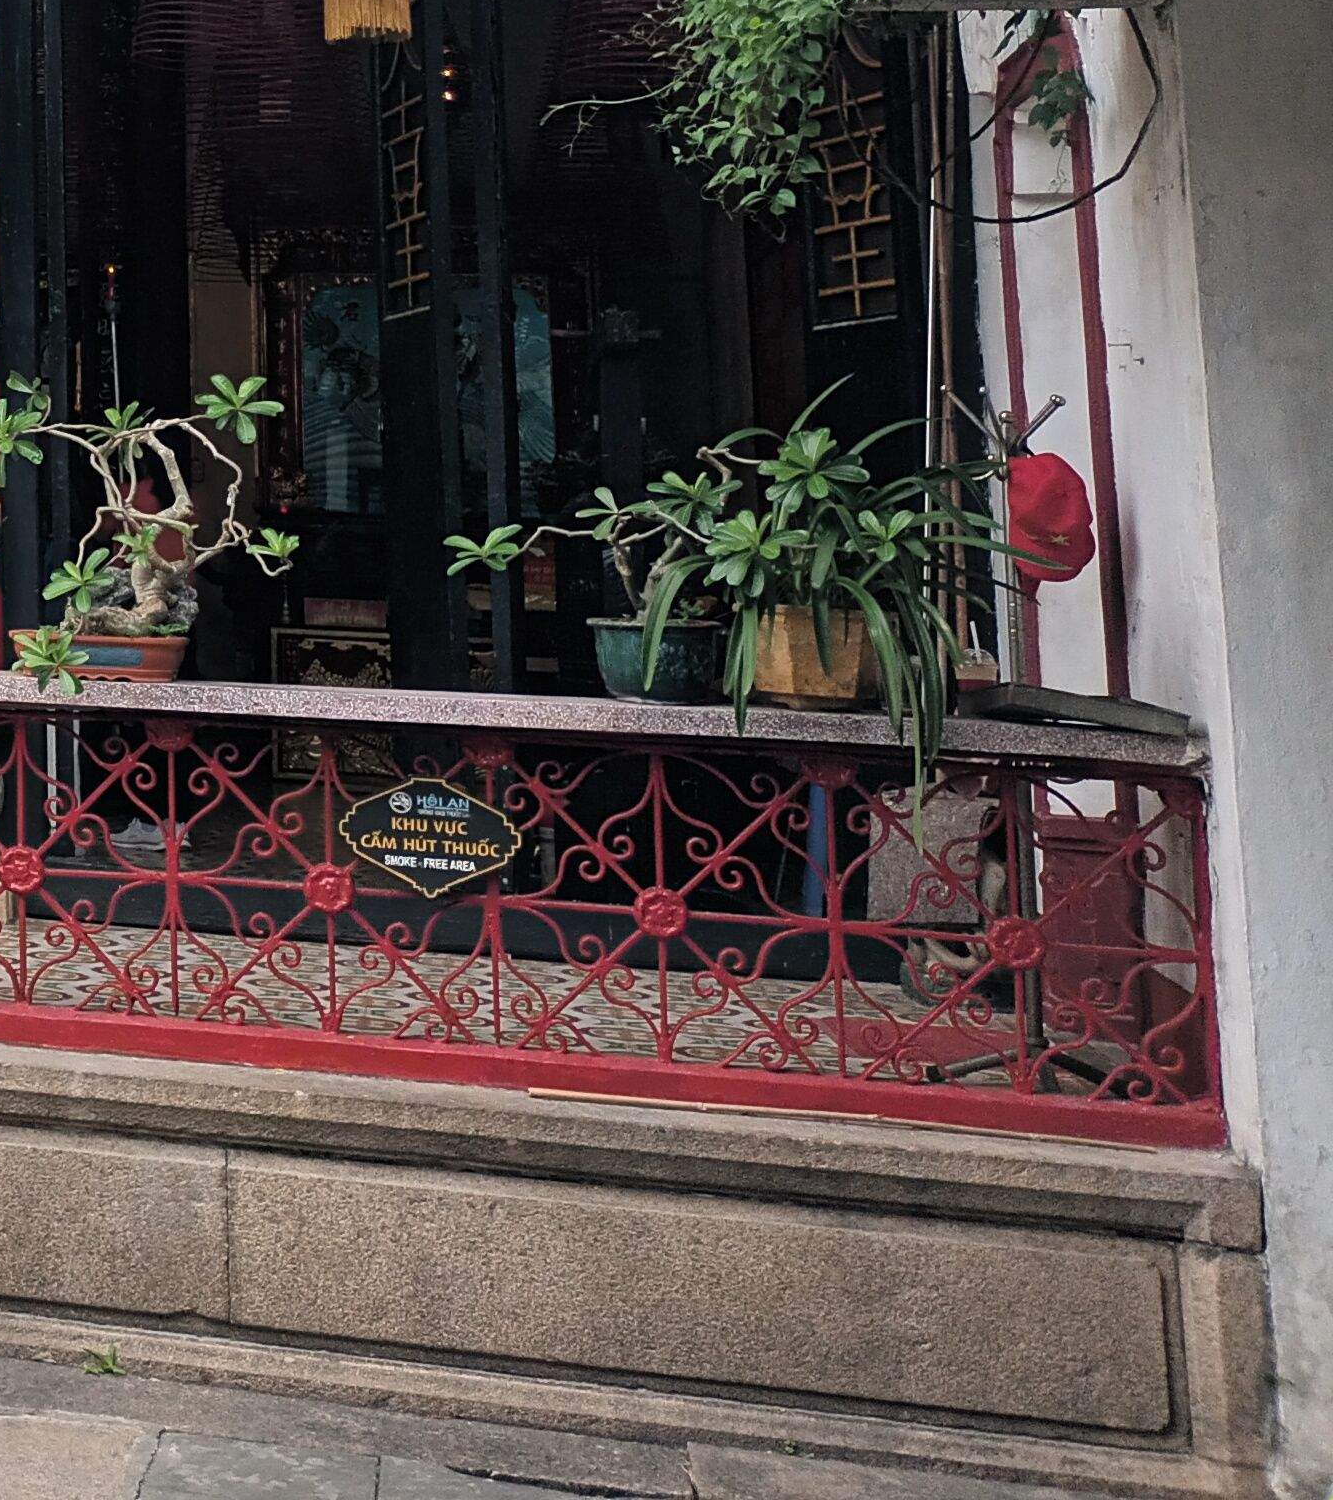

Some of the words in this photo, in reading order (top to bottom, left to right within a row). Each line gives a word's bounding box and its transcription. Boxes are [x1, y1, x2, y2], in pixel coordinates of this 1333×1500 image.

[448, 797, 470, 809] AN
[391, 816, 428, 832] KHU
[433, 819, 468, 836] VỰC
[360, 830, 397, 850] CẤM
[403, 835, 438, 853] HÚT
[442, 838, 501, 858] THUỐC
[384, 854, 418, 867] SMOKE
[423, 857, 449, 870] FREE
[450, 860, 476, 872] AREA
